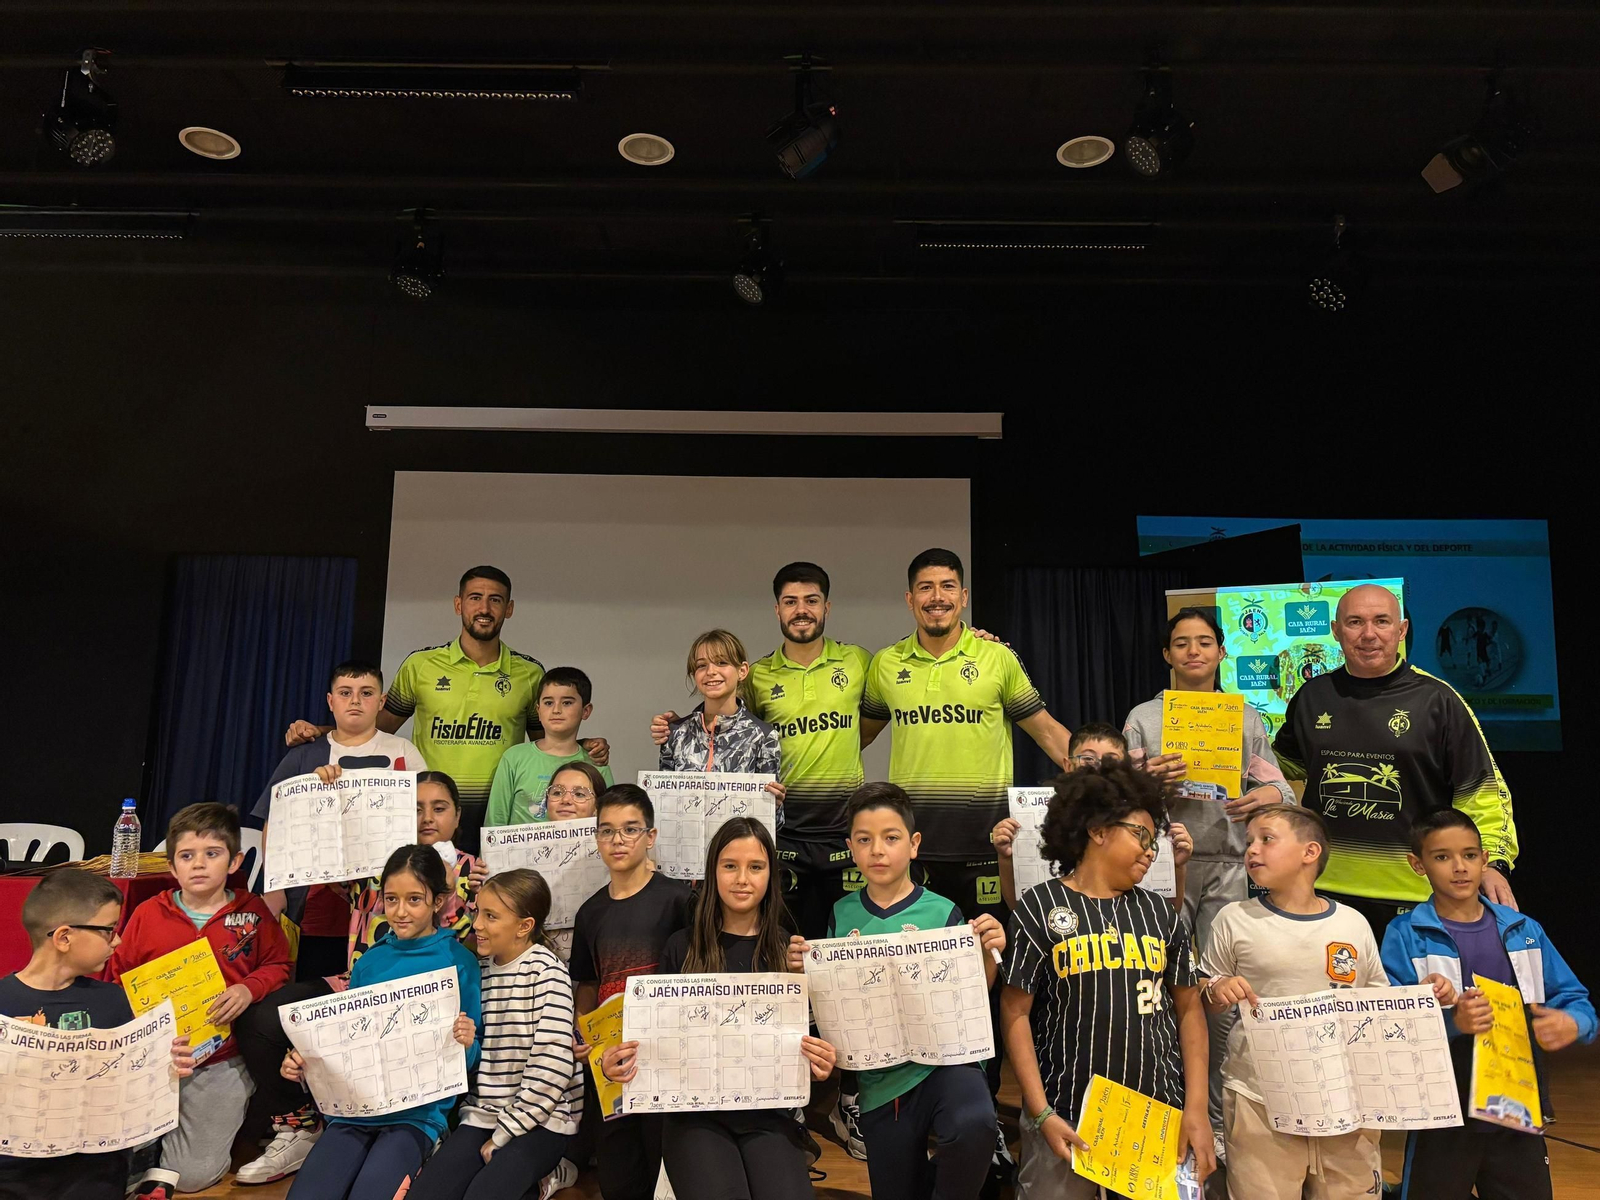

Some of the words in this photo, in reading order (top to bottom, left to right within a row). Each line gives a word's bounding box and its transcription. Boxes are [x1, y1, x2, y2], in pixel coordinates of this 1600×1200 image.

[1378, 542, 1404, 552] FÍSICA
[1433, 544, 1473, 552] DEPORTE
[894, 704, 983, 727] PreVeSSur
[431, 713, 501, 740] FisioÉlite
[1321, 749, 1346, 758] ESPACIO
[1366, 753, 1395, 761] EVENTOS
[284, 783, 308, 798] JAÉN
[311, 778, 350, 793] PARAÍSO
[352, 778, 396, 788] INTERIOR
[398, 779, 411, 788] FS
[655, 779, 678, 790] JAÉN
[679, 779, 716, 791] PARAÍSO
[717, 781, 757, 792] INTERIOR
[1031, 796, 1049, 806] JAÉ
[1323, 798, 1338, 818] La
[500, 832, 525, 845] JAÉN
[527, 828, 568, 842] PARAÍSO
[569, 826, 597, 838] INTER
[776, 850, 797, 861] TER
[830, 849, 851, 862] GEST
[848, 871, 864, 883] LZ
[982, 881, 997, 895] LZ
[826, 947, 854, 962] JAÉN
[856, 944, 903, 960] PARAÍSO
[906, 938, 957, 955] INTERIOR
[960, 936, 974, 949] FS
[357, 989, 374, 998] FIRMA
[649, 984, 679, 998] JAÉN
[681, 983, 731, 997] PARAÍSO
[733, 984, 784, 996] INTERIOR
[787, 984, 801, 995] FS
[306, 1005, 337, 1022] JAÉN
[339, 993, 387, 1015] PARAÍSO
[389, 982, 439, 1003] INTERIOR
[441, 978, 454, 991] FS
[1269, 1006, 1302, 1021] JAÉN
[1304, 999, 1354, 1018] PARAÍSO
[1356, 998, 1415, 1012] INTERIOR
[1418, 997, 1435, 1009] FS
[11, 1032, 44, 1050] JAÉN
[48, 1037, 107, 1053] PARAÍSO
[110, 1023, 158, 1050] INTERIOR
[159, 1013, 171, 1029] FS
[72, 1032, 92, 1040] FIRMA
[1153, 1154, 1160, 1165] LZ
